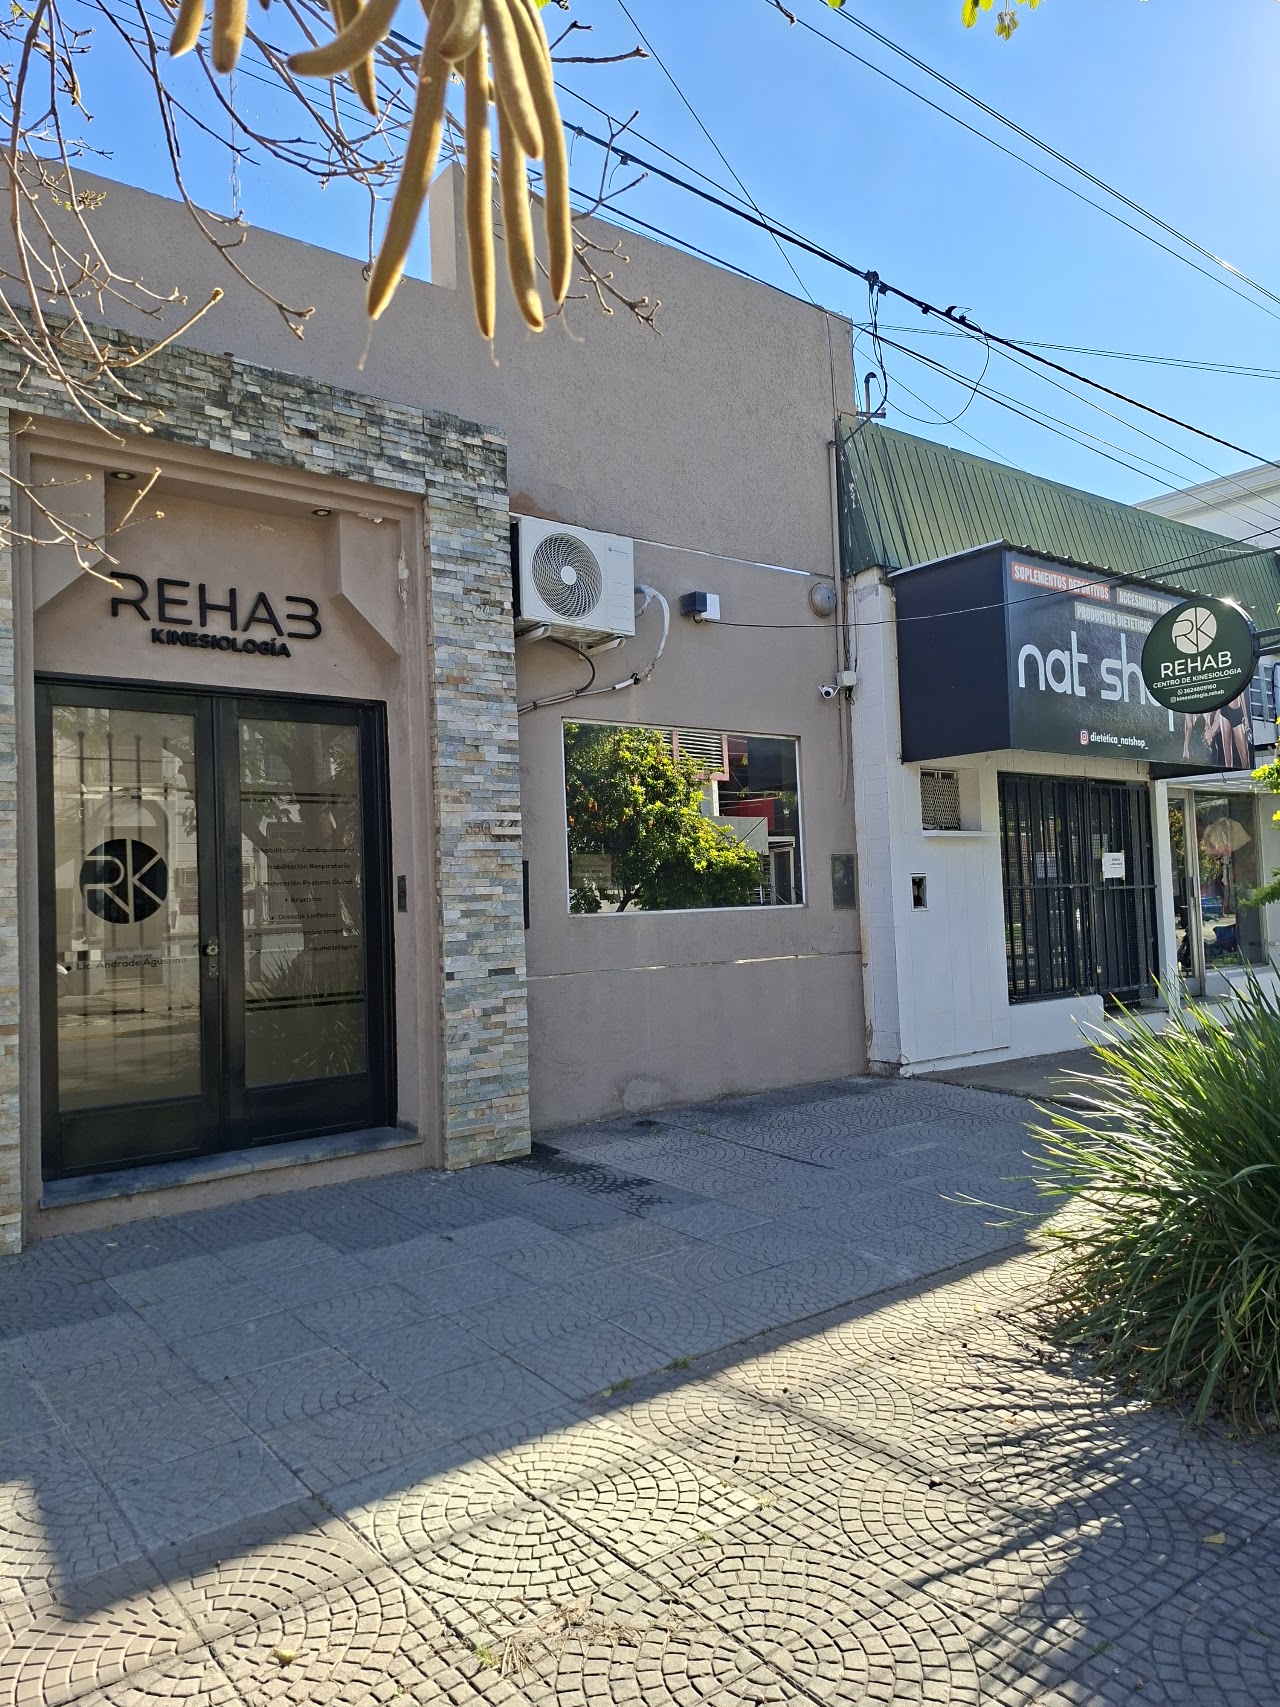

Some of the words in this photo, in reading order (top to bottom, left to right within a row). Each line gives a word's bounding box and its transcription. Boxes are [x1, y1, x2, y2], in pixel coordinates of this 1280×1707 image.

[1014, 565, 1066, 589] SUPLEMENTOS
[1068, 578, 1109, 599] DEPORTIVOS
[110, 571, 322, 639] REHAB
[1119, 591, 1157, 611] ACCESORIOS
[1077, 606, 1116, 625] PRODUCTOS
[1117, 617, 1152, 633] DIETETICOS
[151, 628, 292, 657] KINESIOLOGÍA
[1018, 631, 1088, 697] nat
[1160, 651, 1232, 678] REHAB
[1153, 678, 1180, 689] CENTRO
[1181, 676, 1191, 684] DE
[1192, 668, 1241, 682] KINESIOLOGIA
[1090, 731, 1149, 750] dietética_natshop_
[97, 959, 141, 969] Andrade
